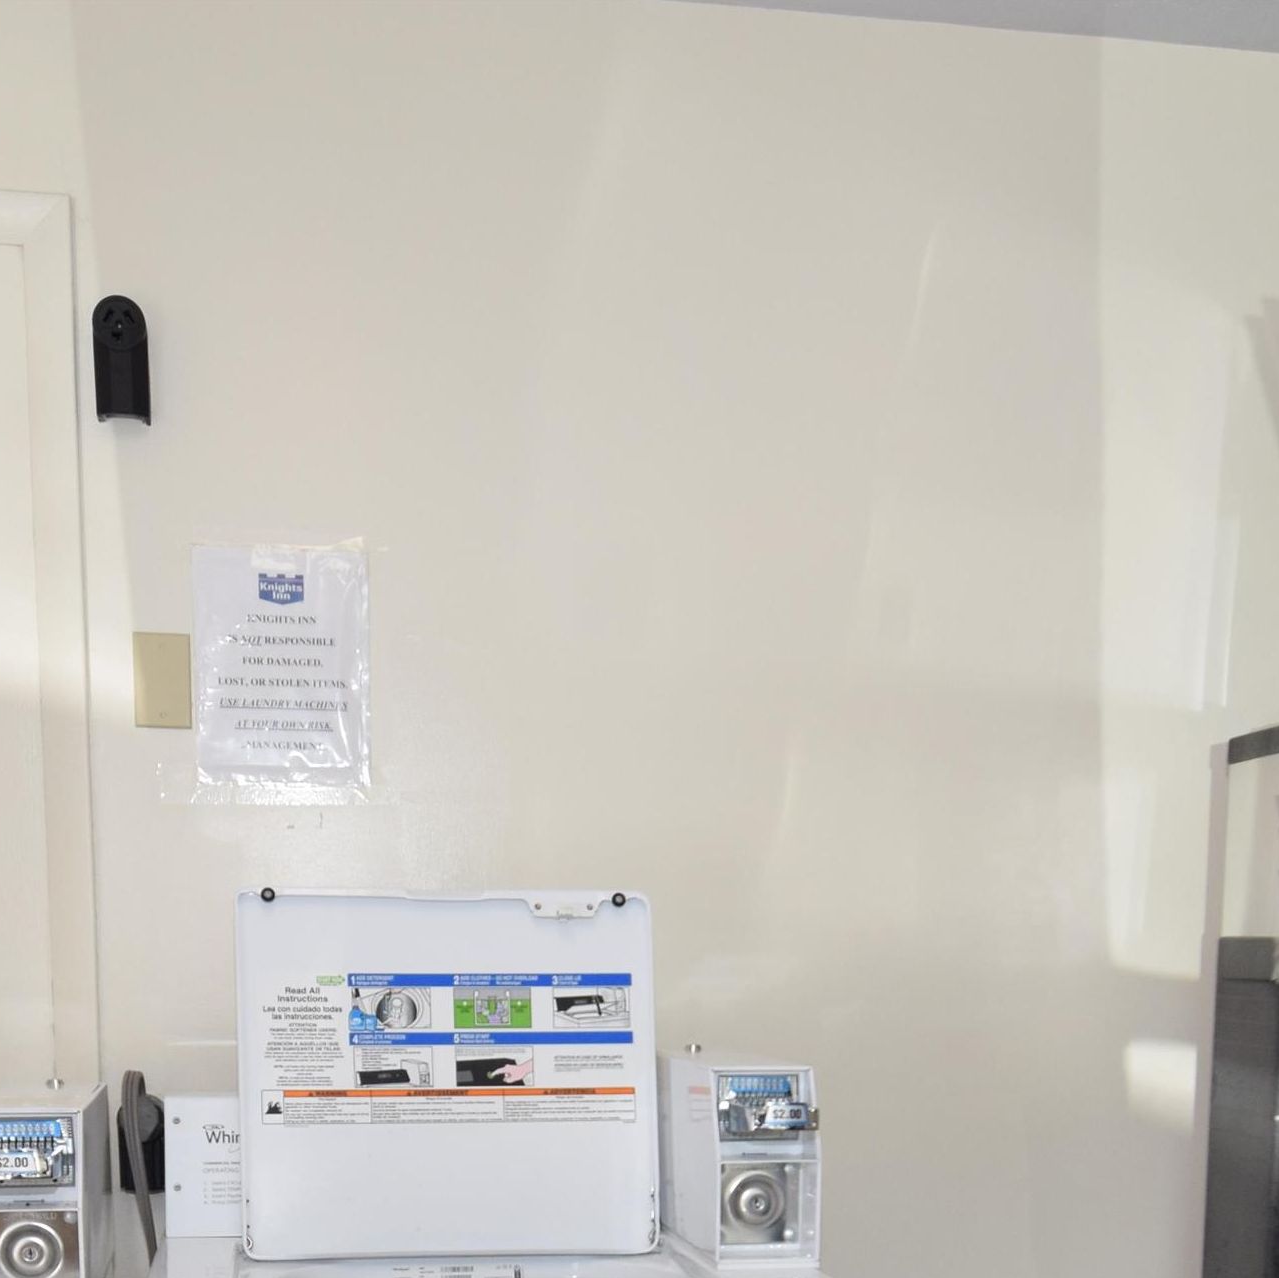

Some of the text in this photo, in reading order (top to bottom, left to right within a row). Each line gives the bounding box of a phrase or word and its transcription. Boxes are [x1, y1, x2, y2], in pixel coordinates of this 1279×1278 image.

[260, 582, 303, 593] Knights
[272, 591, 291, 600] Inn
[247, 614, 317, 624] KNIGHTS INN
[264, 636, 335, 646] RESPONSIBLE
[242, 656, 265, 665] FOR
[218, 676, 249, 687] LOST,
[250, 678, 266, 687] OR
[268, 678, 310, 688] STOLEN
[351, 975, 356, 985] 1
[453, 975, 460, 985] 2
[552, 975, 558, 985] 3
[284, 986, 321, 994] Read All
[277, 995, 329, 1003] Instructions
[352, 1034, 359, 1044] 4
[453, 1034, 460, 1043] 5
[772, 1108, 802, 1119] $2.00
[205, 1130, 240, 1144] Whir
